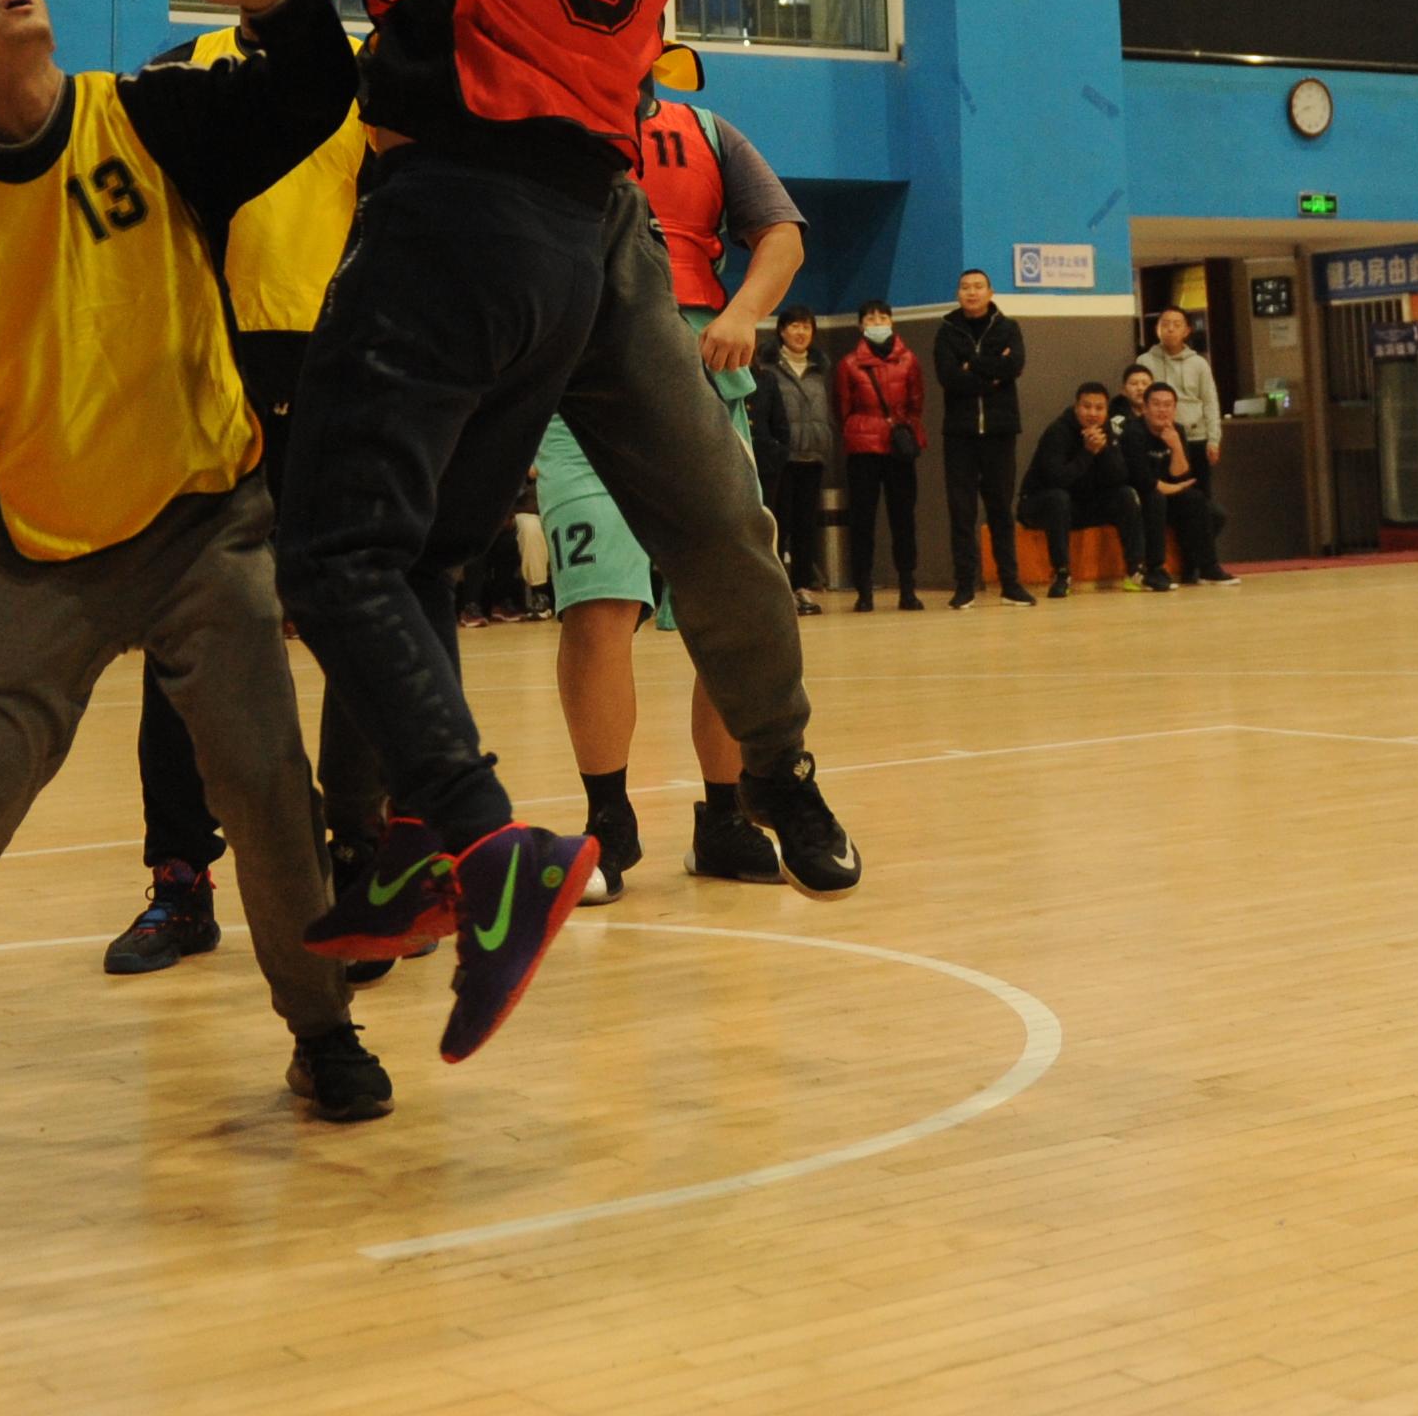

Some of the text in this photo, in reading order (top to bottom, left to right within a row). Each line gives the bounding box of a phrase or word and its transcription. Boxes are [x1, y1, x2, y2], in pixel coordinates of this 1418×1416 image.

[650, 130, 688, 169] 11
[65, 155, 149, 244] 13
[551, 521, 597, 573] 12
